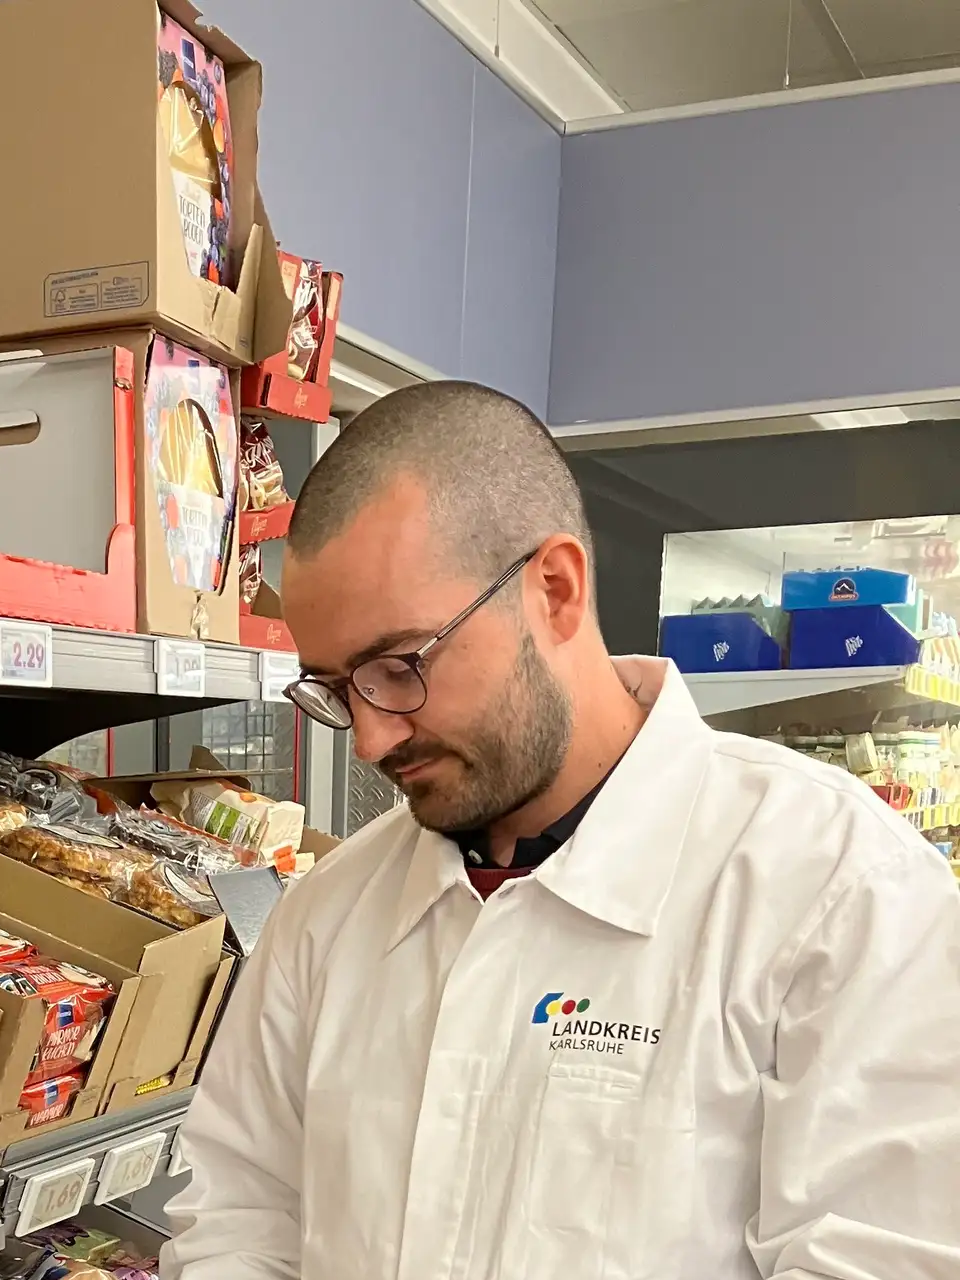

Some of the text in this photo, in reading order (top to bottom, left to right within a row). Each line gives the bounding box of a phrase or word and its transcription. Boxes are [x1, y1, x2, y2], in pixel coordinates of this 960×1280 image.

[13, 642, 44, 669] 2.29
[552, 1020, 660, 1044] LANDKREIS
[549, 1039, 624, 1055] KARLSRUHE
[45, 1181, 81, 1212] 1.69
